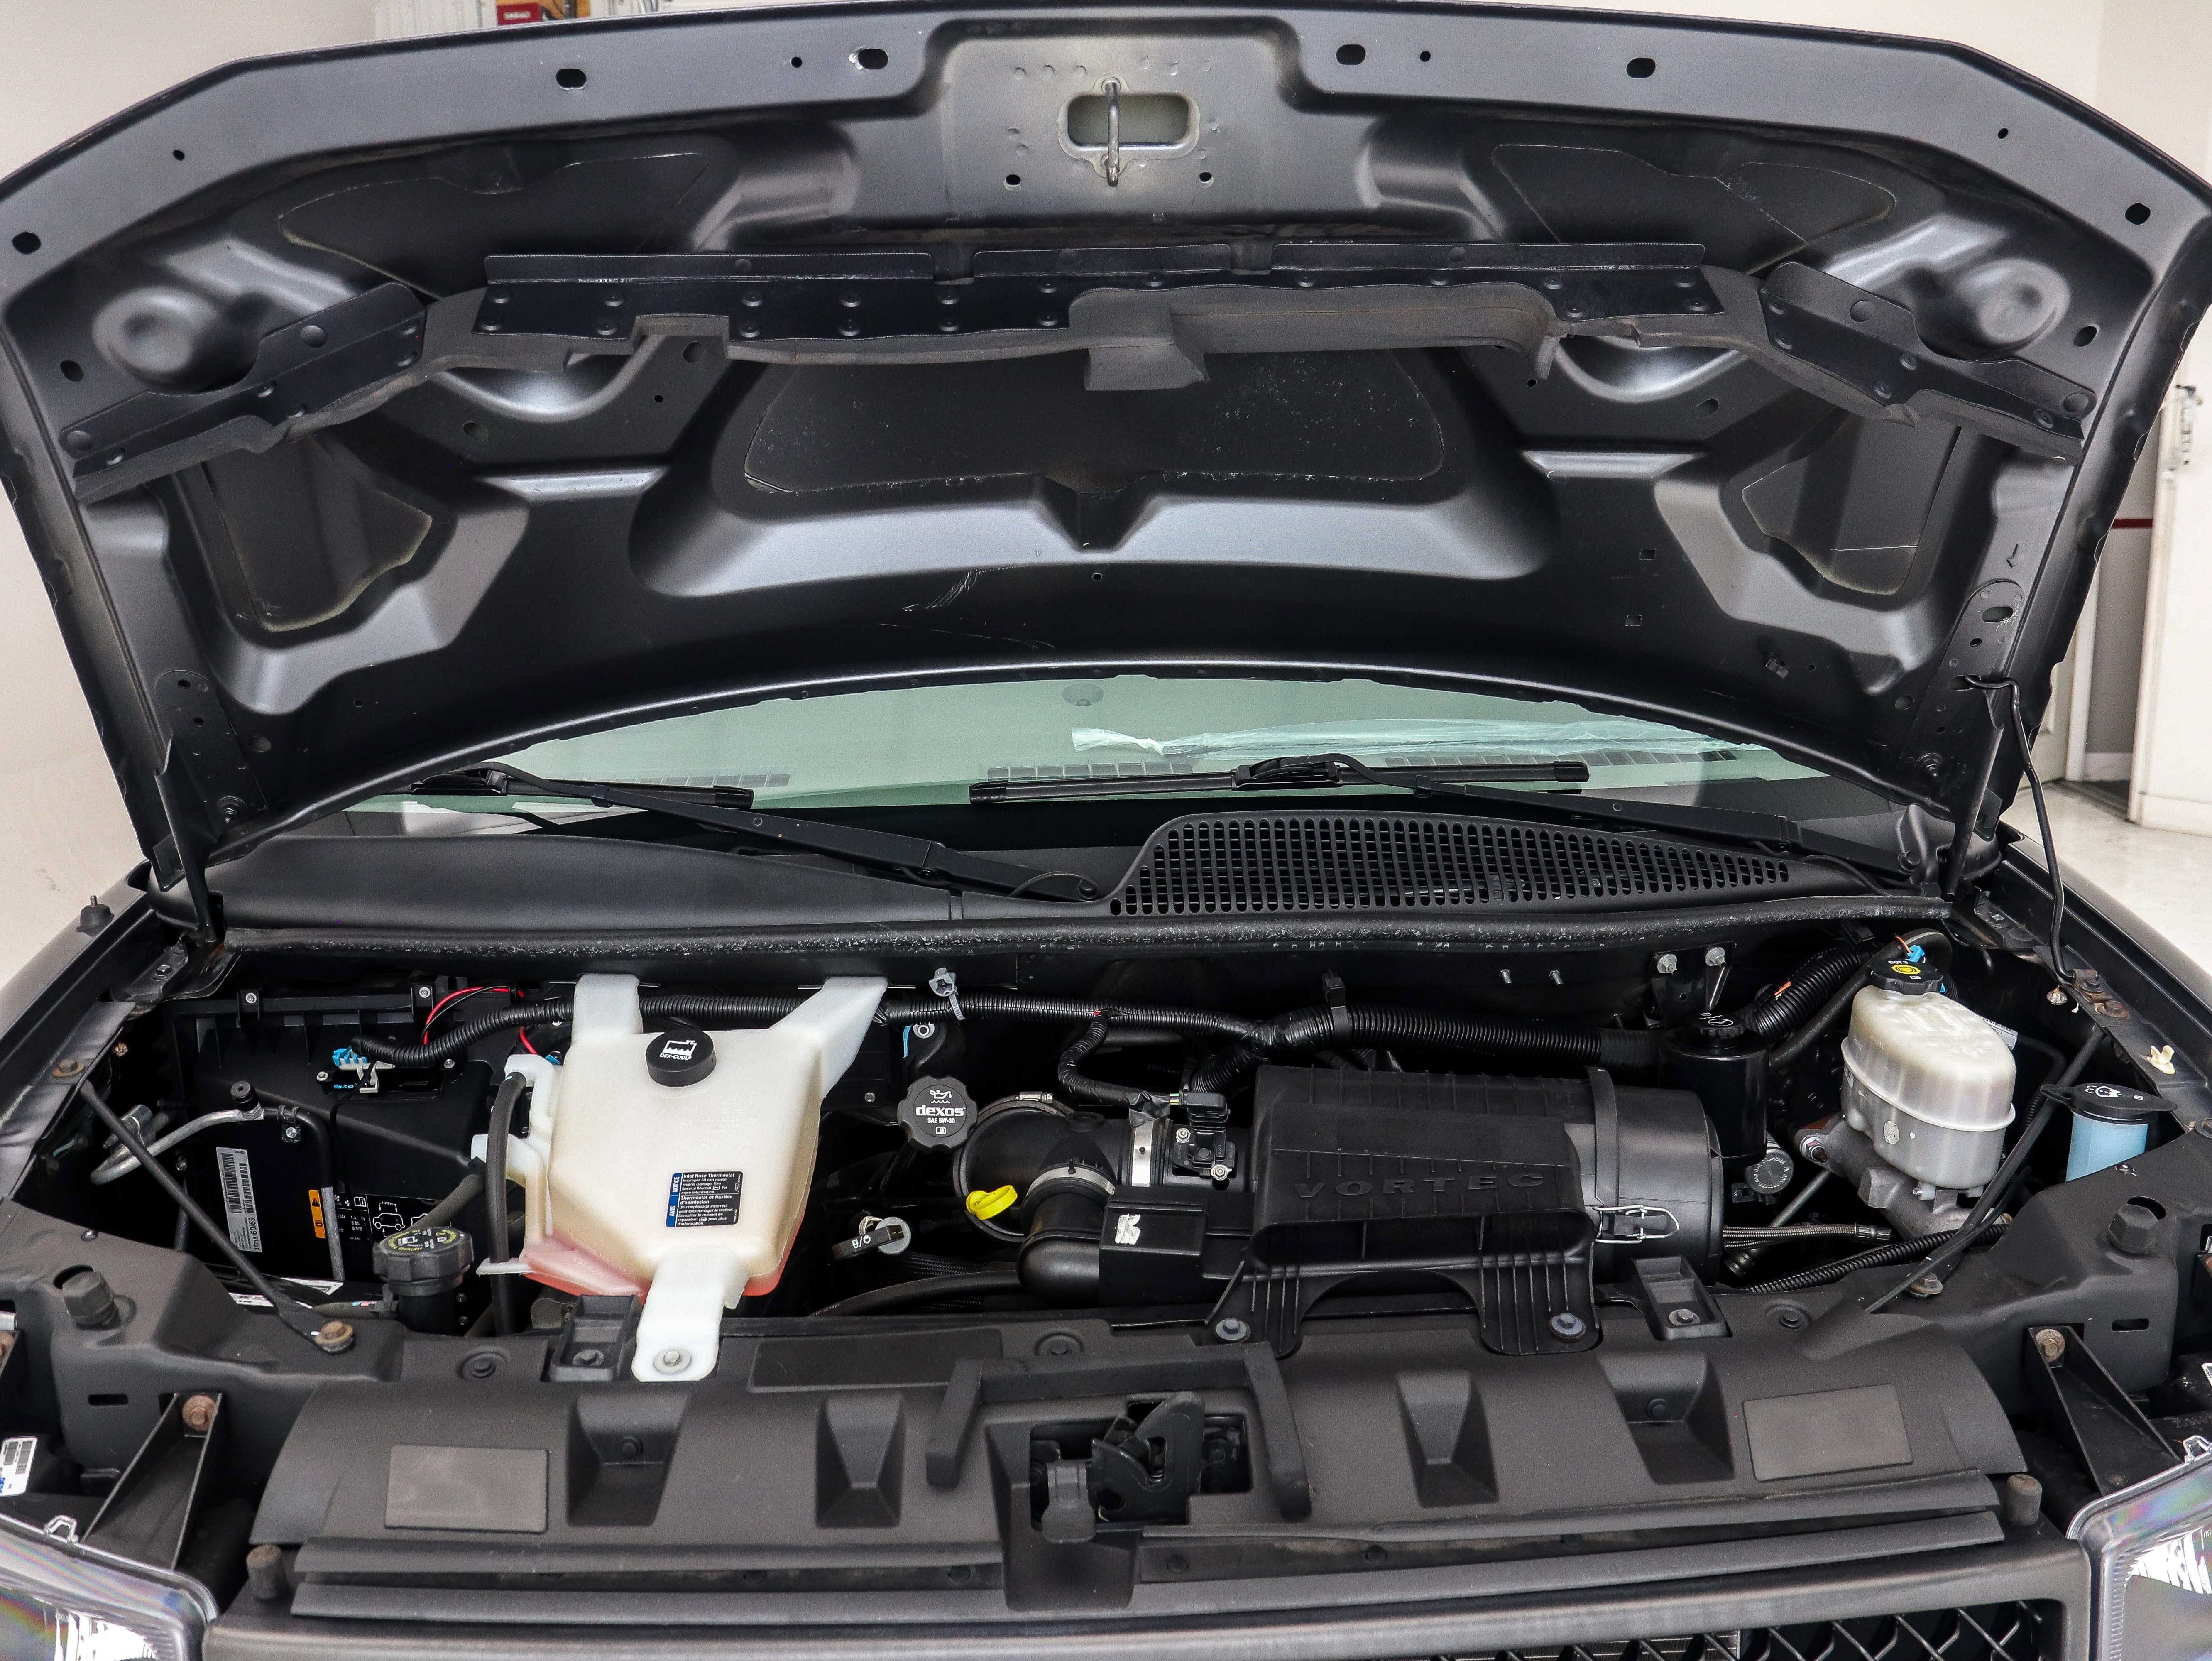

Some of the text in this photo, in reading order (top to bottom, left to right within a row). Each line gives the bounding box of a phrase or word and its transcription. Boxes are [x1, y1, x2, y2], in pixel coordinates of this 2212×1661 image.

[916, 1105, 964, 1116] dexos
[1294, 1172, 1544, 1198] VORTEC
[248, 1217, 257, 1235] 60/69
